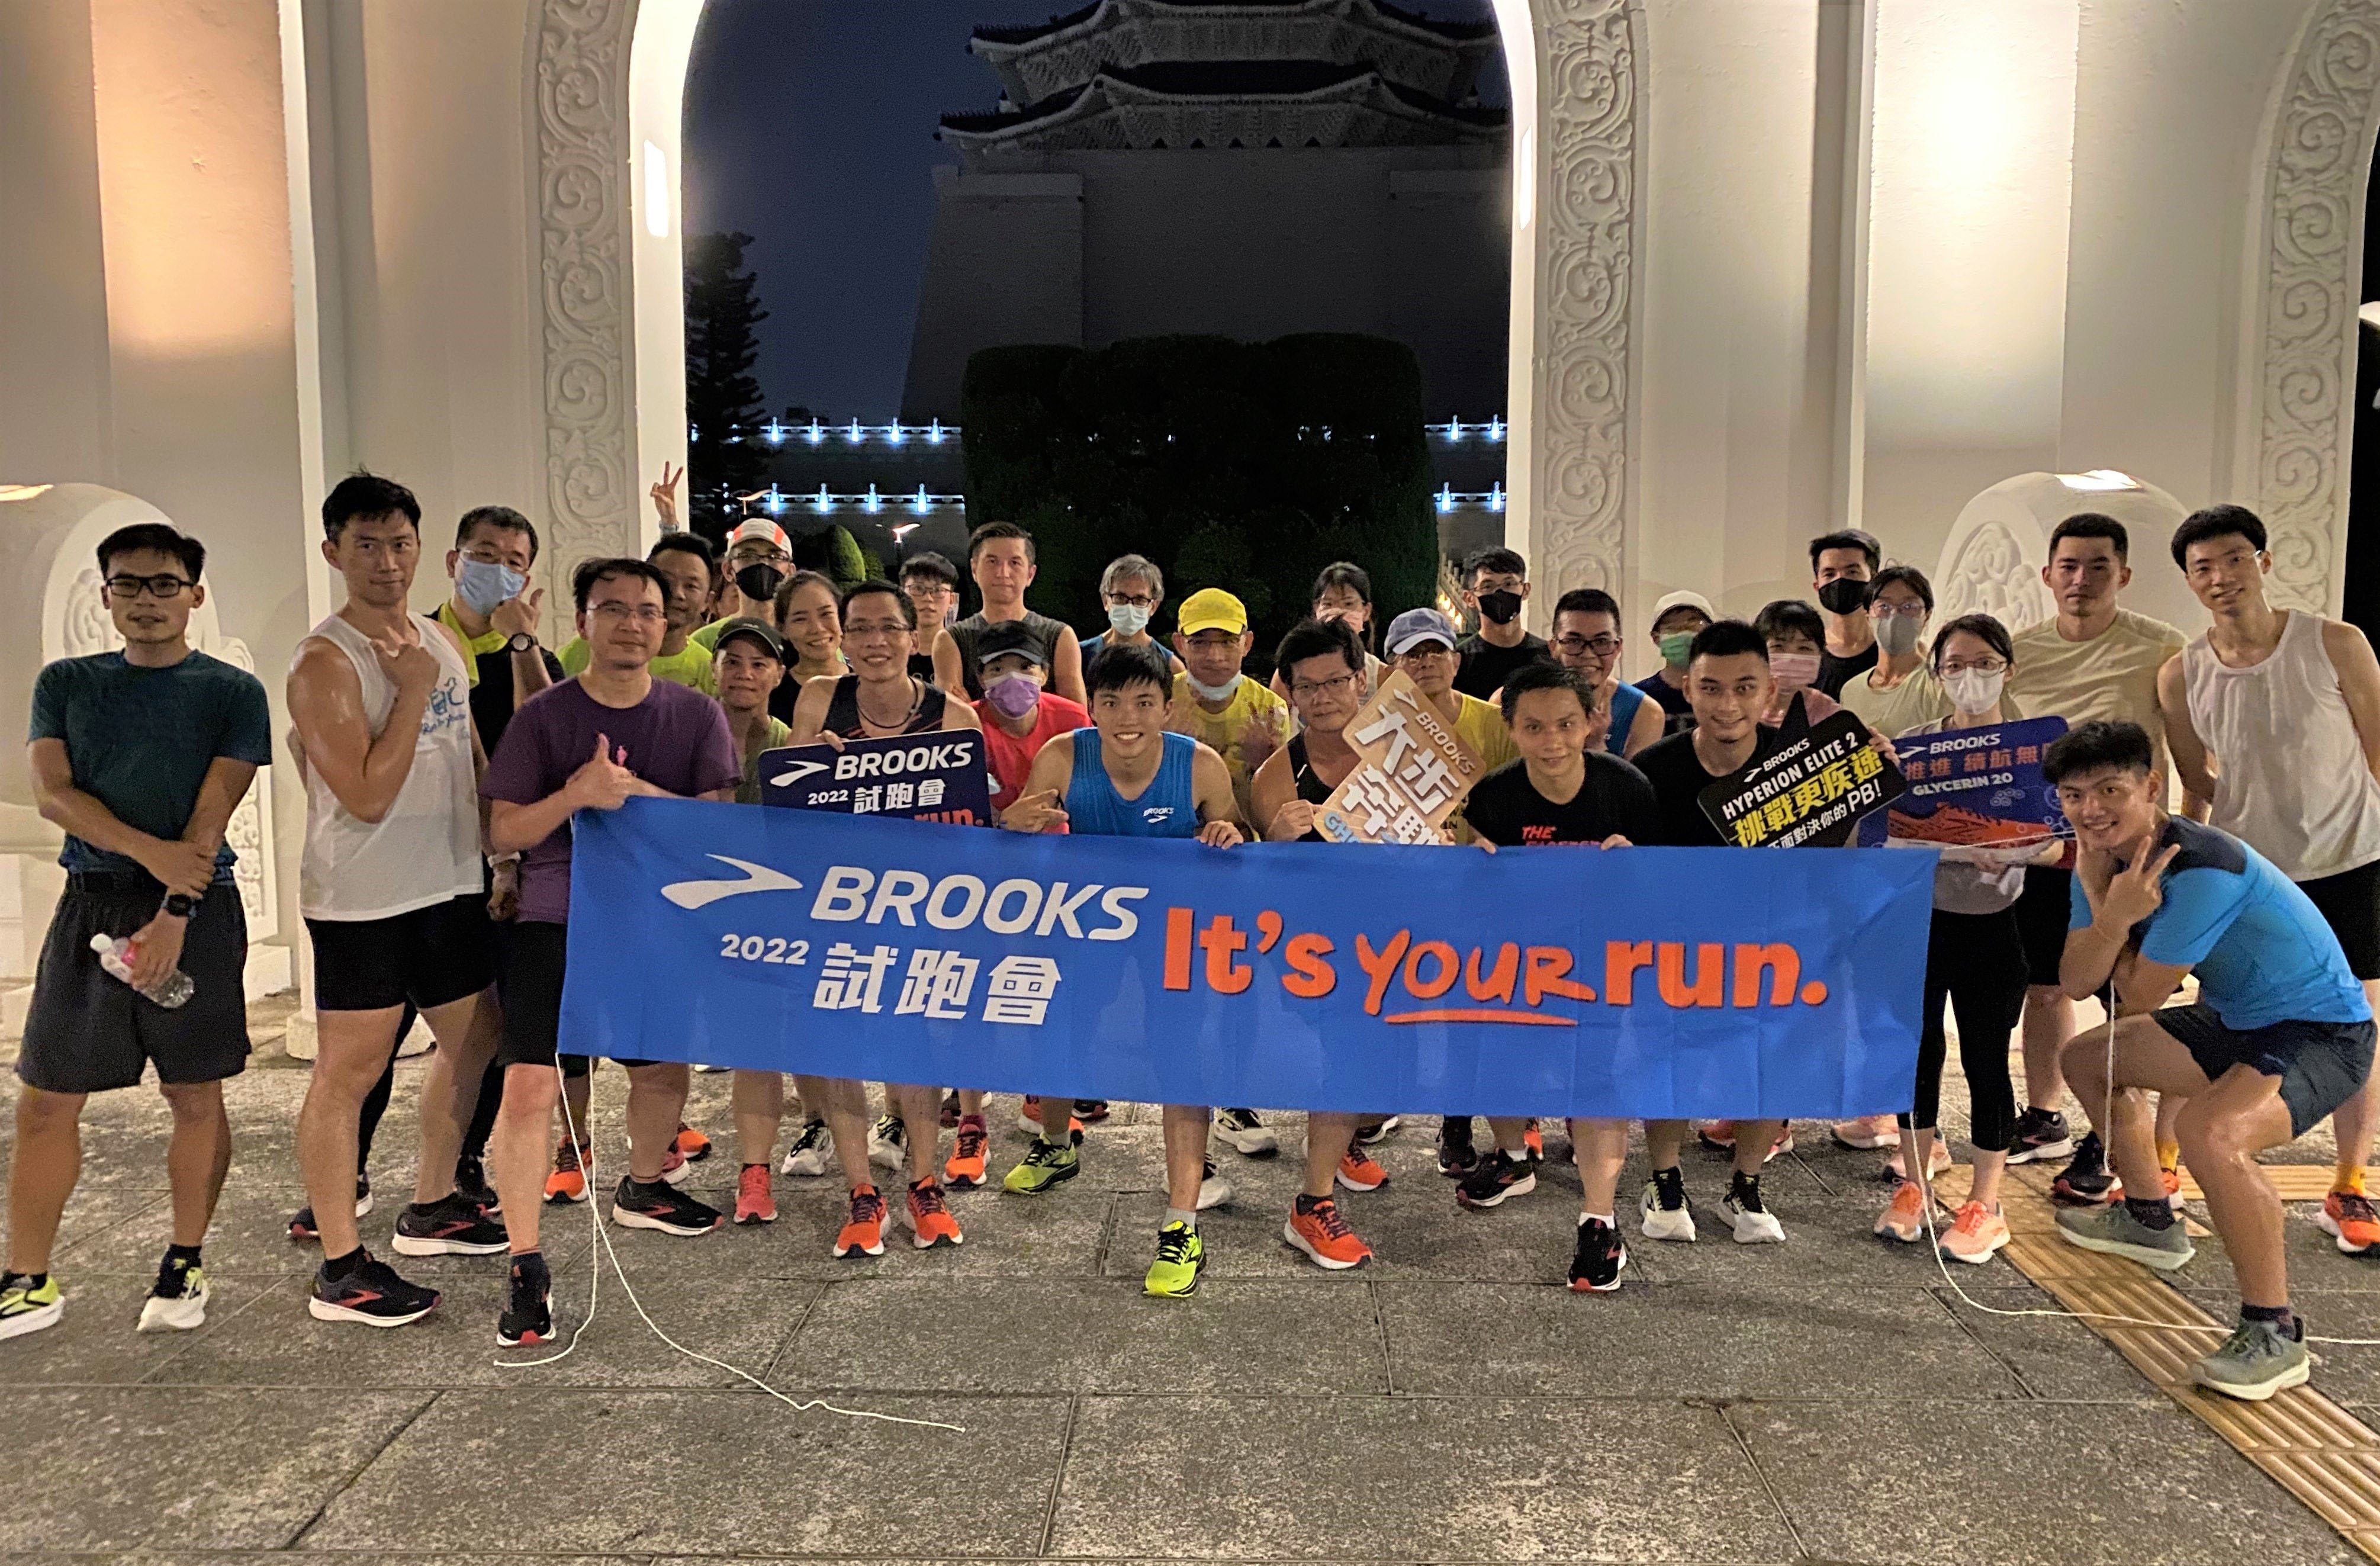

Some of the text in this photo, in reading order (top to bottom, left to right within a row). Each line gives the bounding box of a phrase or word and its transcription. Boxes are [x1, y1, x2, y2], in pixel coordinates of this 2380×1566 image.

[834, 742, 974, 780] BROOKS
[1355, 704, 1460, 815] 大步
[1416, 712, 1476, 775] BROOKS
[1763, 738, 1810, 772] BROOKS
[1929, 733, 2001, 755] BROOKS
[1722, 732, 1858, 820] HYPERION ELITE 2
[1913, 772, 2014, 796] GLYCERIN 20
[808, 779, 946, 814] 2022 試跑會
[1143, 807, 1174, 816] BROOKS
[1730, 745, 1884, 848] 挑戰更疾速
[1847, 779, 1882, 813] PB!
[1522, 825, 1556, 839] THE
[811, 866, 1148, 940] BROOKS
[721, 934, 1062, 1025] 2022 試跑會
[1356, 929, 1597, 1016] YOUR
[1604, 940, 1829, 1009] run.
